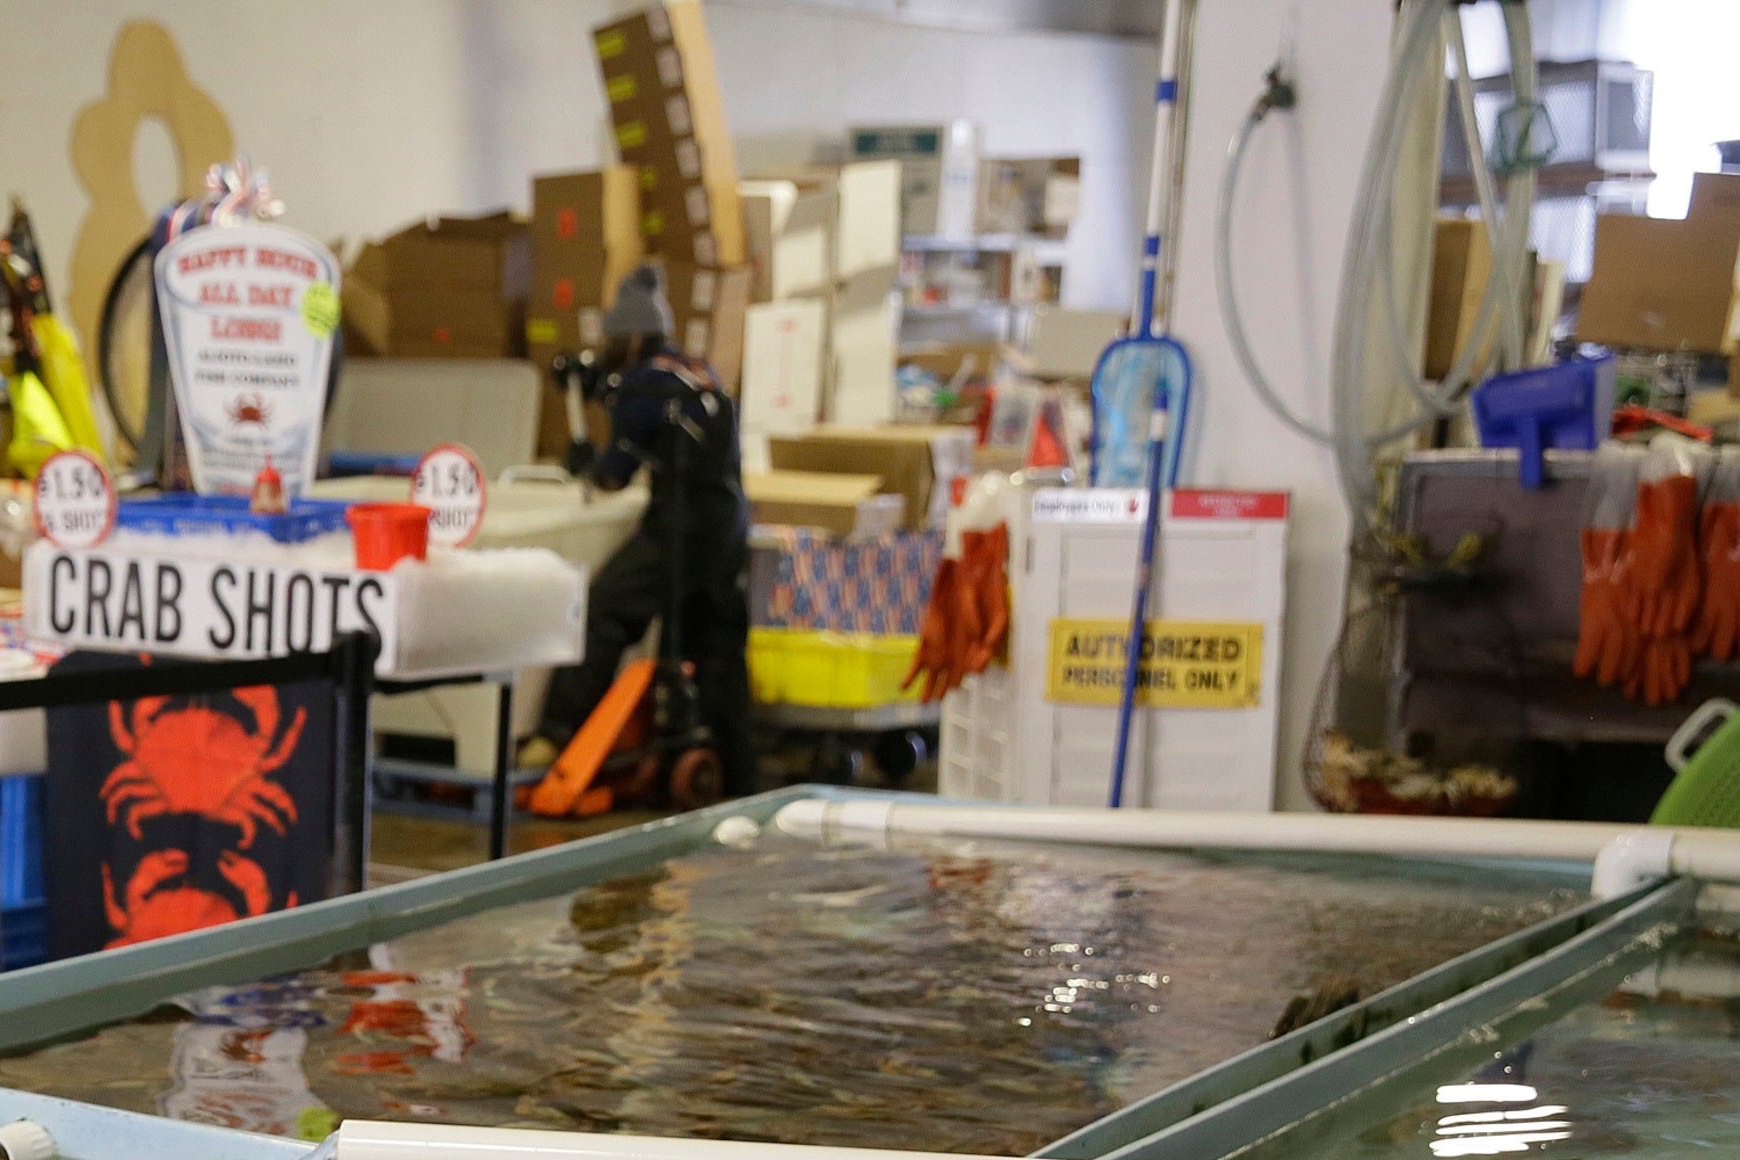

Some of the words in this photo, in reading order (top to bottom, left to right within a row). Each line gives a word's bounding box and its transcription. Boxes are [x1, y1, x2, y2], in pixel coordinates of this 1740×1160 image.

[178, 247, 246, 275] HAPPY
[256, 248, 317, 280] HOUR
[199, 283, 239, 305] ALL
[248, 285, 294, 308] DAY
[50, 555, 183, 643] CRAB
[208, 567, 385, 660] SHOTS
[1066, 632, 1240, 662] AUTORIZED
[1064, 664, 1176, 690] PERSONEL
[1184, 669, 1238, 691] ONLY
